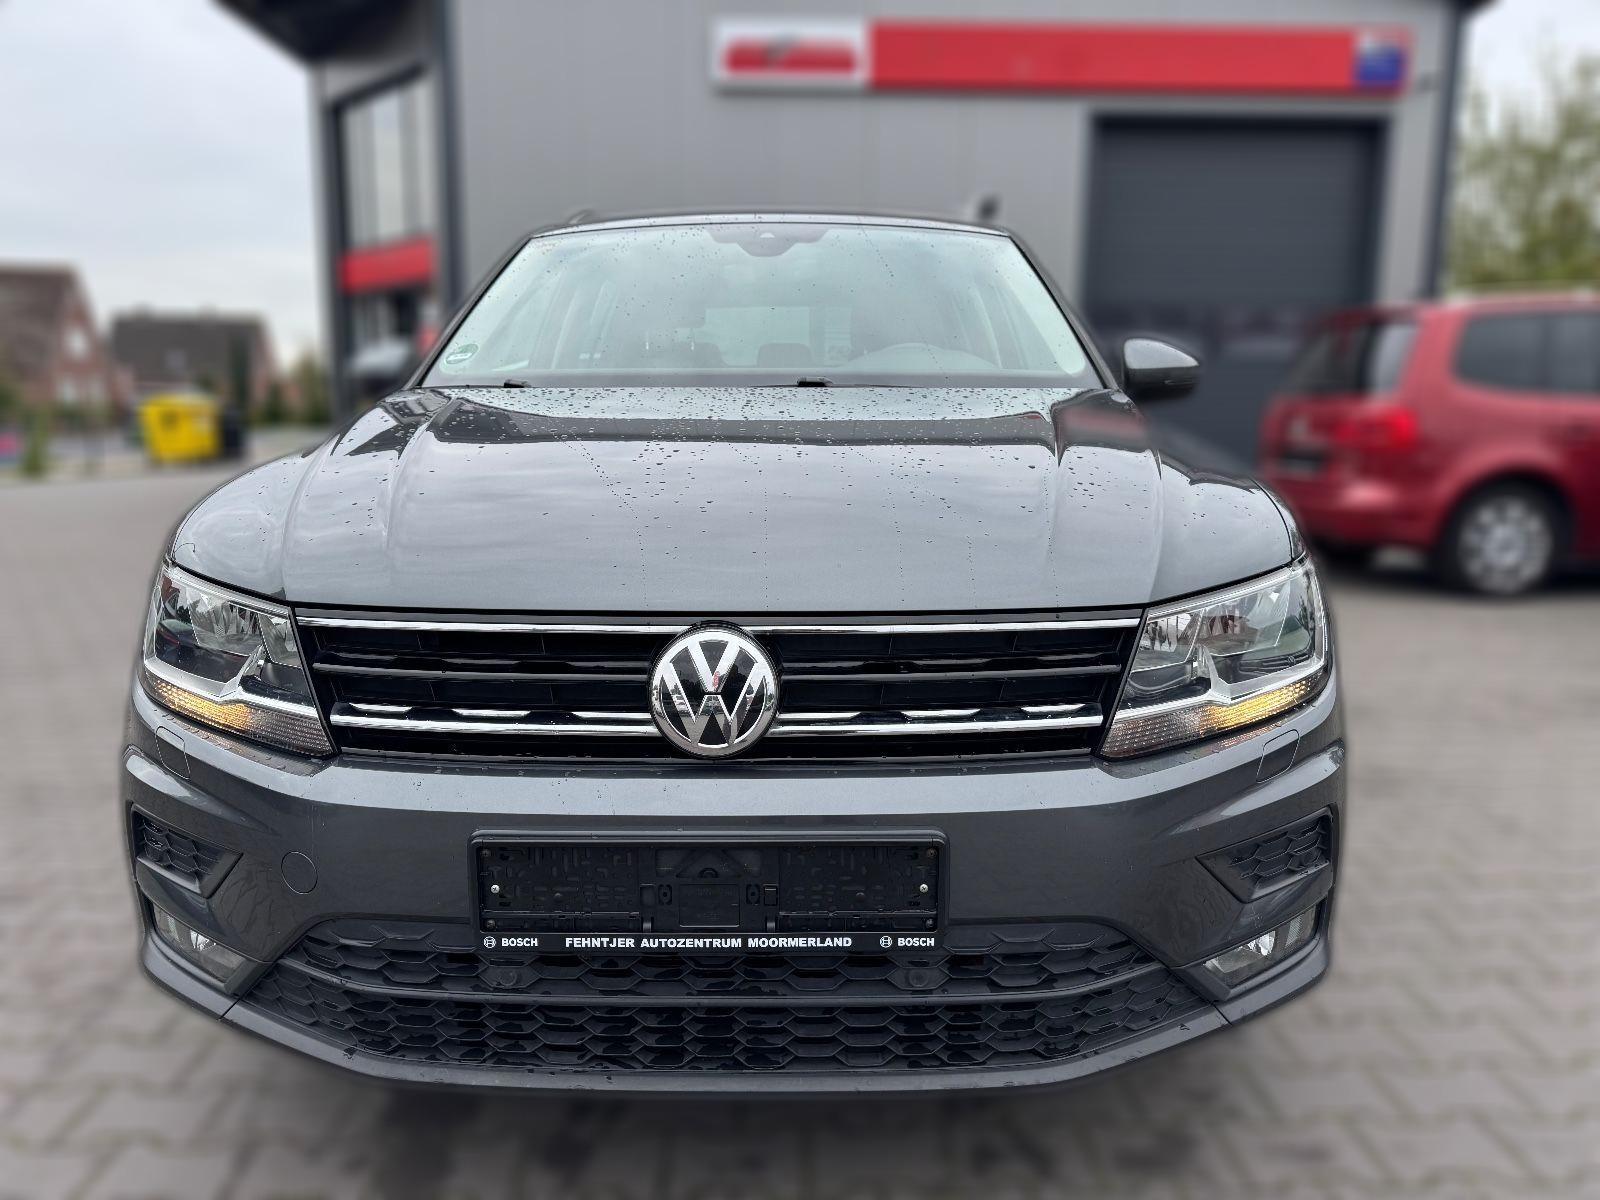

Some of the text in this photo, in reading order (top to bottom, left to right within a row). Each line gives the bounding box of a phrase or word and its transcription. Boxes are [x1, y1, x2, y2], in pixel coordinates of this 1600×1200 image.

[654, 633, 776, 754] VW
[501, 937, 539, 947] BOSCH
[565, 937, 852, 948] FEHNTJER AUTOZENTRUM MOORMERLAND
[897, 937, 935, 947] BOSCH
